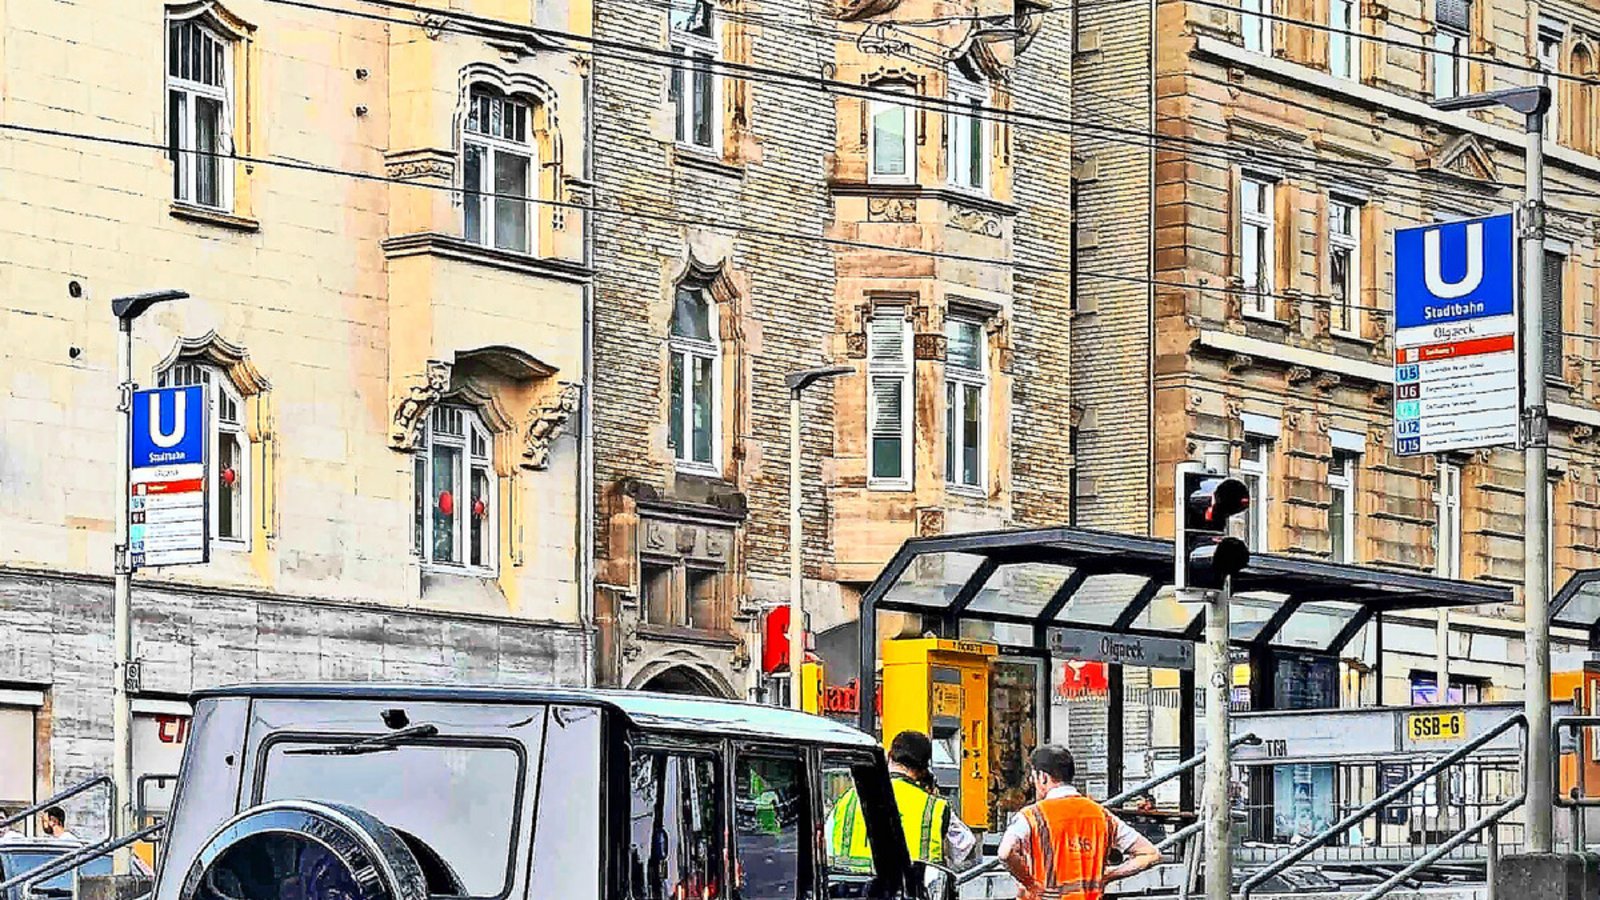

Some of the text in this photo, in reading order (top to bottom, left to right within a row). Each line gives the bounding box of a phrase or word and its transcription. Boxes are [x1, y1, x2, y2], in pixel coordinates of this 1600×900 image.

[1424, 222, 1484, 299] U
[1424, 301, 1485, 320] Stadtbahn
[1399, 367, 1418, 381] U5
[1399, 384, 1418, 398] U6
[149, 390, 187, 448] U
[1398, 420, 1420, 434] U12
[1398, 439, 1420, 454] U15
[1413, 715, 1460, 736] SSB-G
